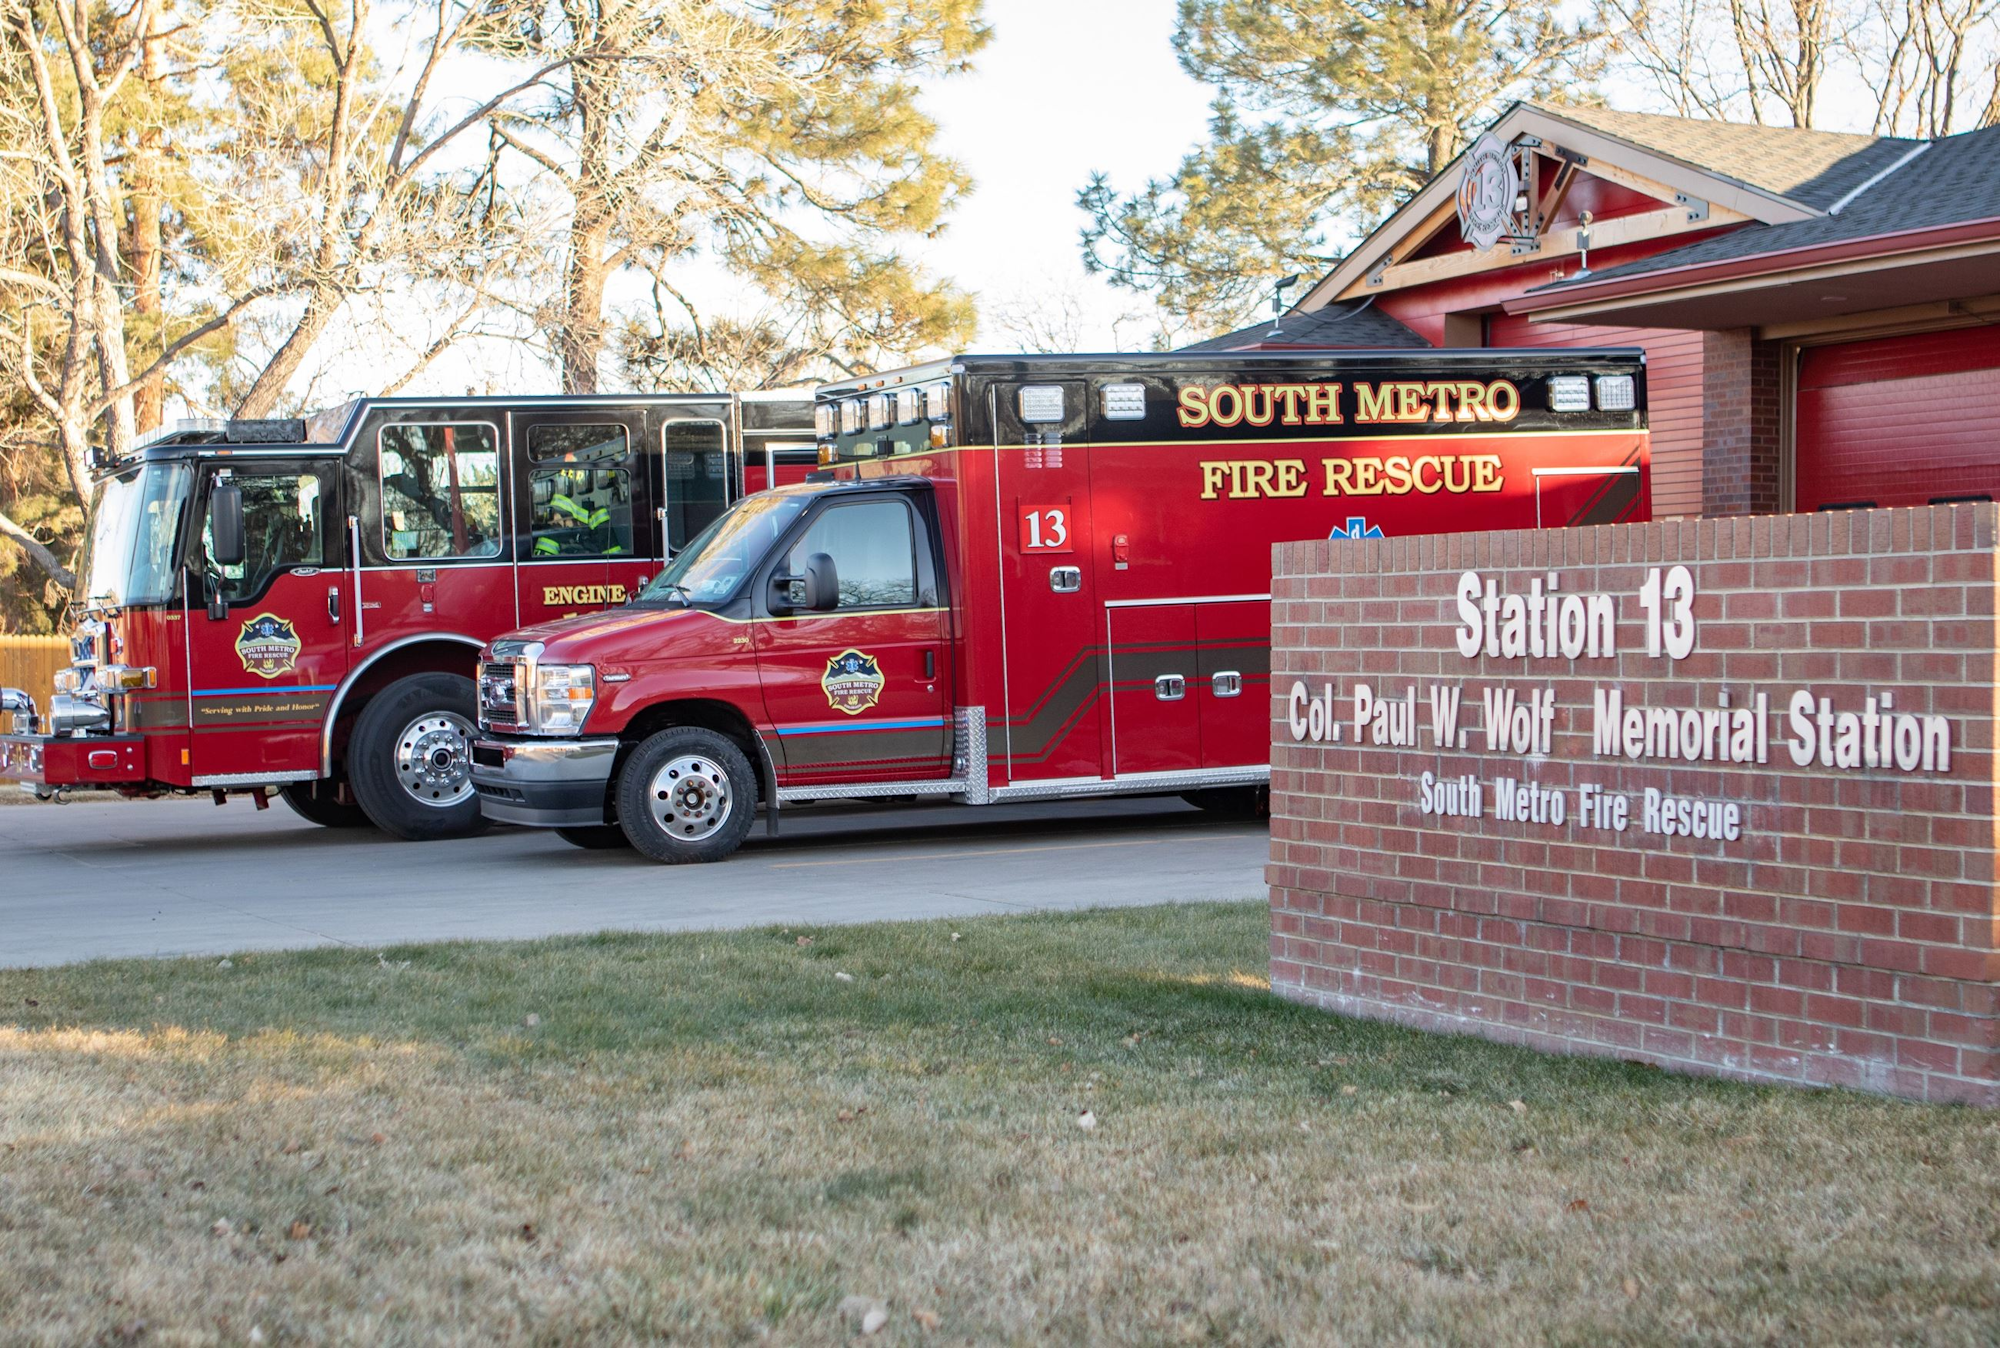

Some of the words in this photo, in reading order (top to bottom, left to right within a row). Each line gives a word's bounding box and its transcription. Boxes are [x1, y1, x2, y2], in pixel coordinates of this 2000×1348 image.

[1473, 170, 1503, 212] 13
[1178, 382, 1344, 428] SOUTH
[1354, 380, 1521, 424] METRO
[1200, 458, 1308, 499] FIRE
[1322, 454, 1504, 497] RESCUE
[1025, 509, 1067, 548] 13
[543, 584, 626, 605] ENGINE
[1456, 571, 1615, 660] Station
[1640, 565, 1695, 660] 13
[241, 645, 266, 655] SOUTH
[268, 645, 295, 653] METRO
[828, 682, 852, 692] SOUTH
[853, 681, 879, 689] METRO
[235, 705, 252, 713] with
[254, 704, 274, 713] Pride
[1289, 681, 1342, 742] Col.
[1354, 684, 1416, 746] Paul
[1430, 685, 1467, 749] W.
[1484, 687, 1556, 754] Wolf
[1594, 688, 1768, 764] Memorial
[1788, 690, 1951, 772] Station
[1420, 770, 1484, 818] South
[1495, 777, 1567, 826] Metro
[1579, 783, 1630, 832] Fire
[1644, 787, 1742, 842] Rescue
